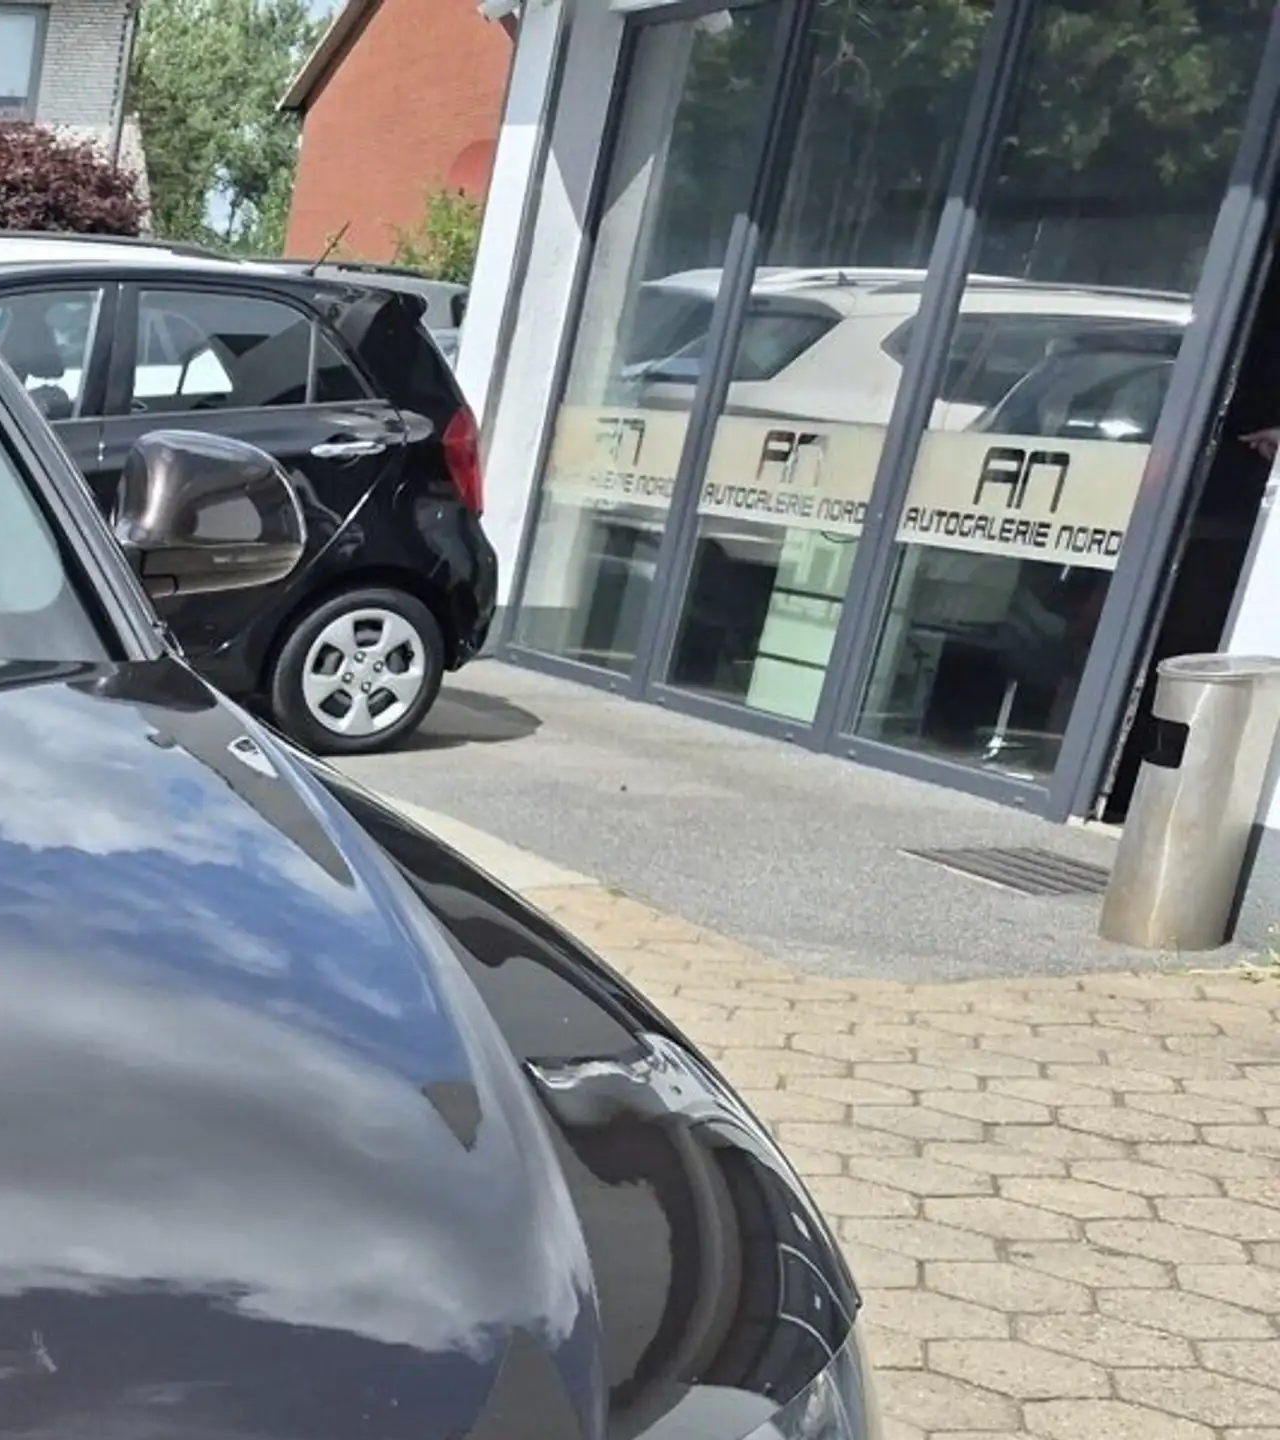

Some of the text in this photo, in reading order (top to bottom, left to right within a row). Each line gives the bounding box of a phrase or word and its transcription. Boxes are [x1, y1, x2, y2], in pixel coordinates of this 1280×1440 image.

[701, 481, 869, 525] AUTOGALERIE NORD
[972, 446, 1071, 514] AN
[902, 506, 1124, 556] AUTOGALERIE NORD
